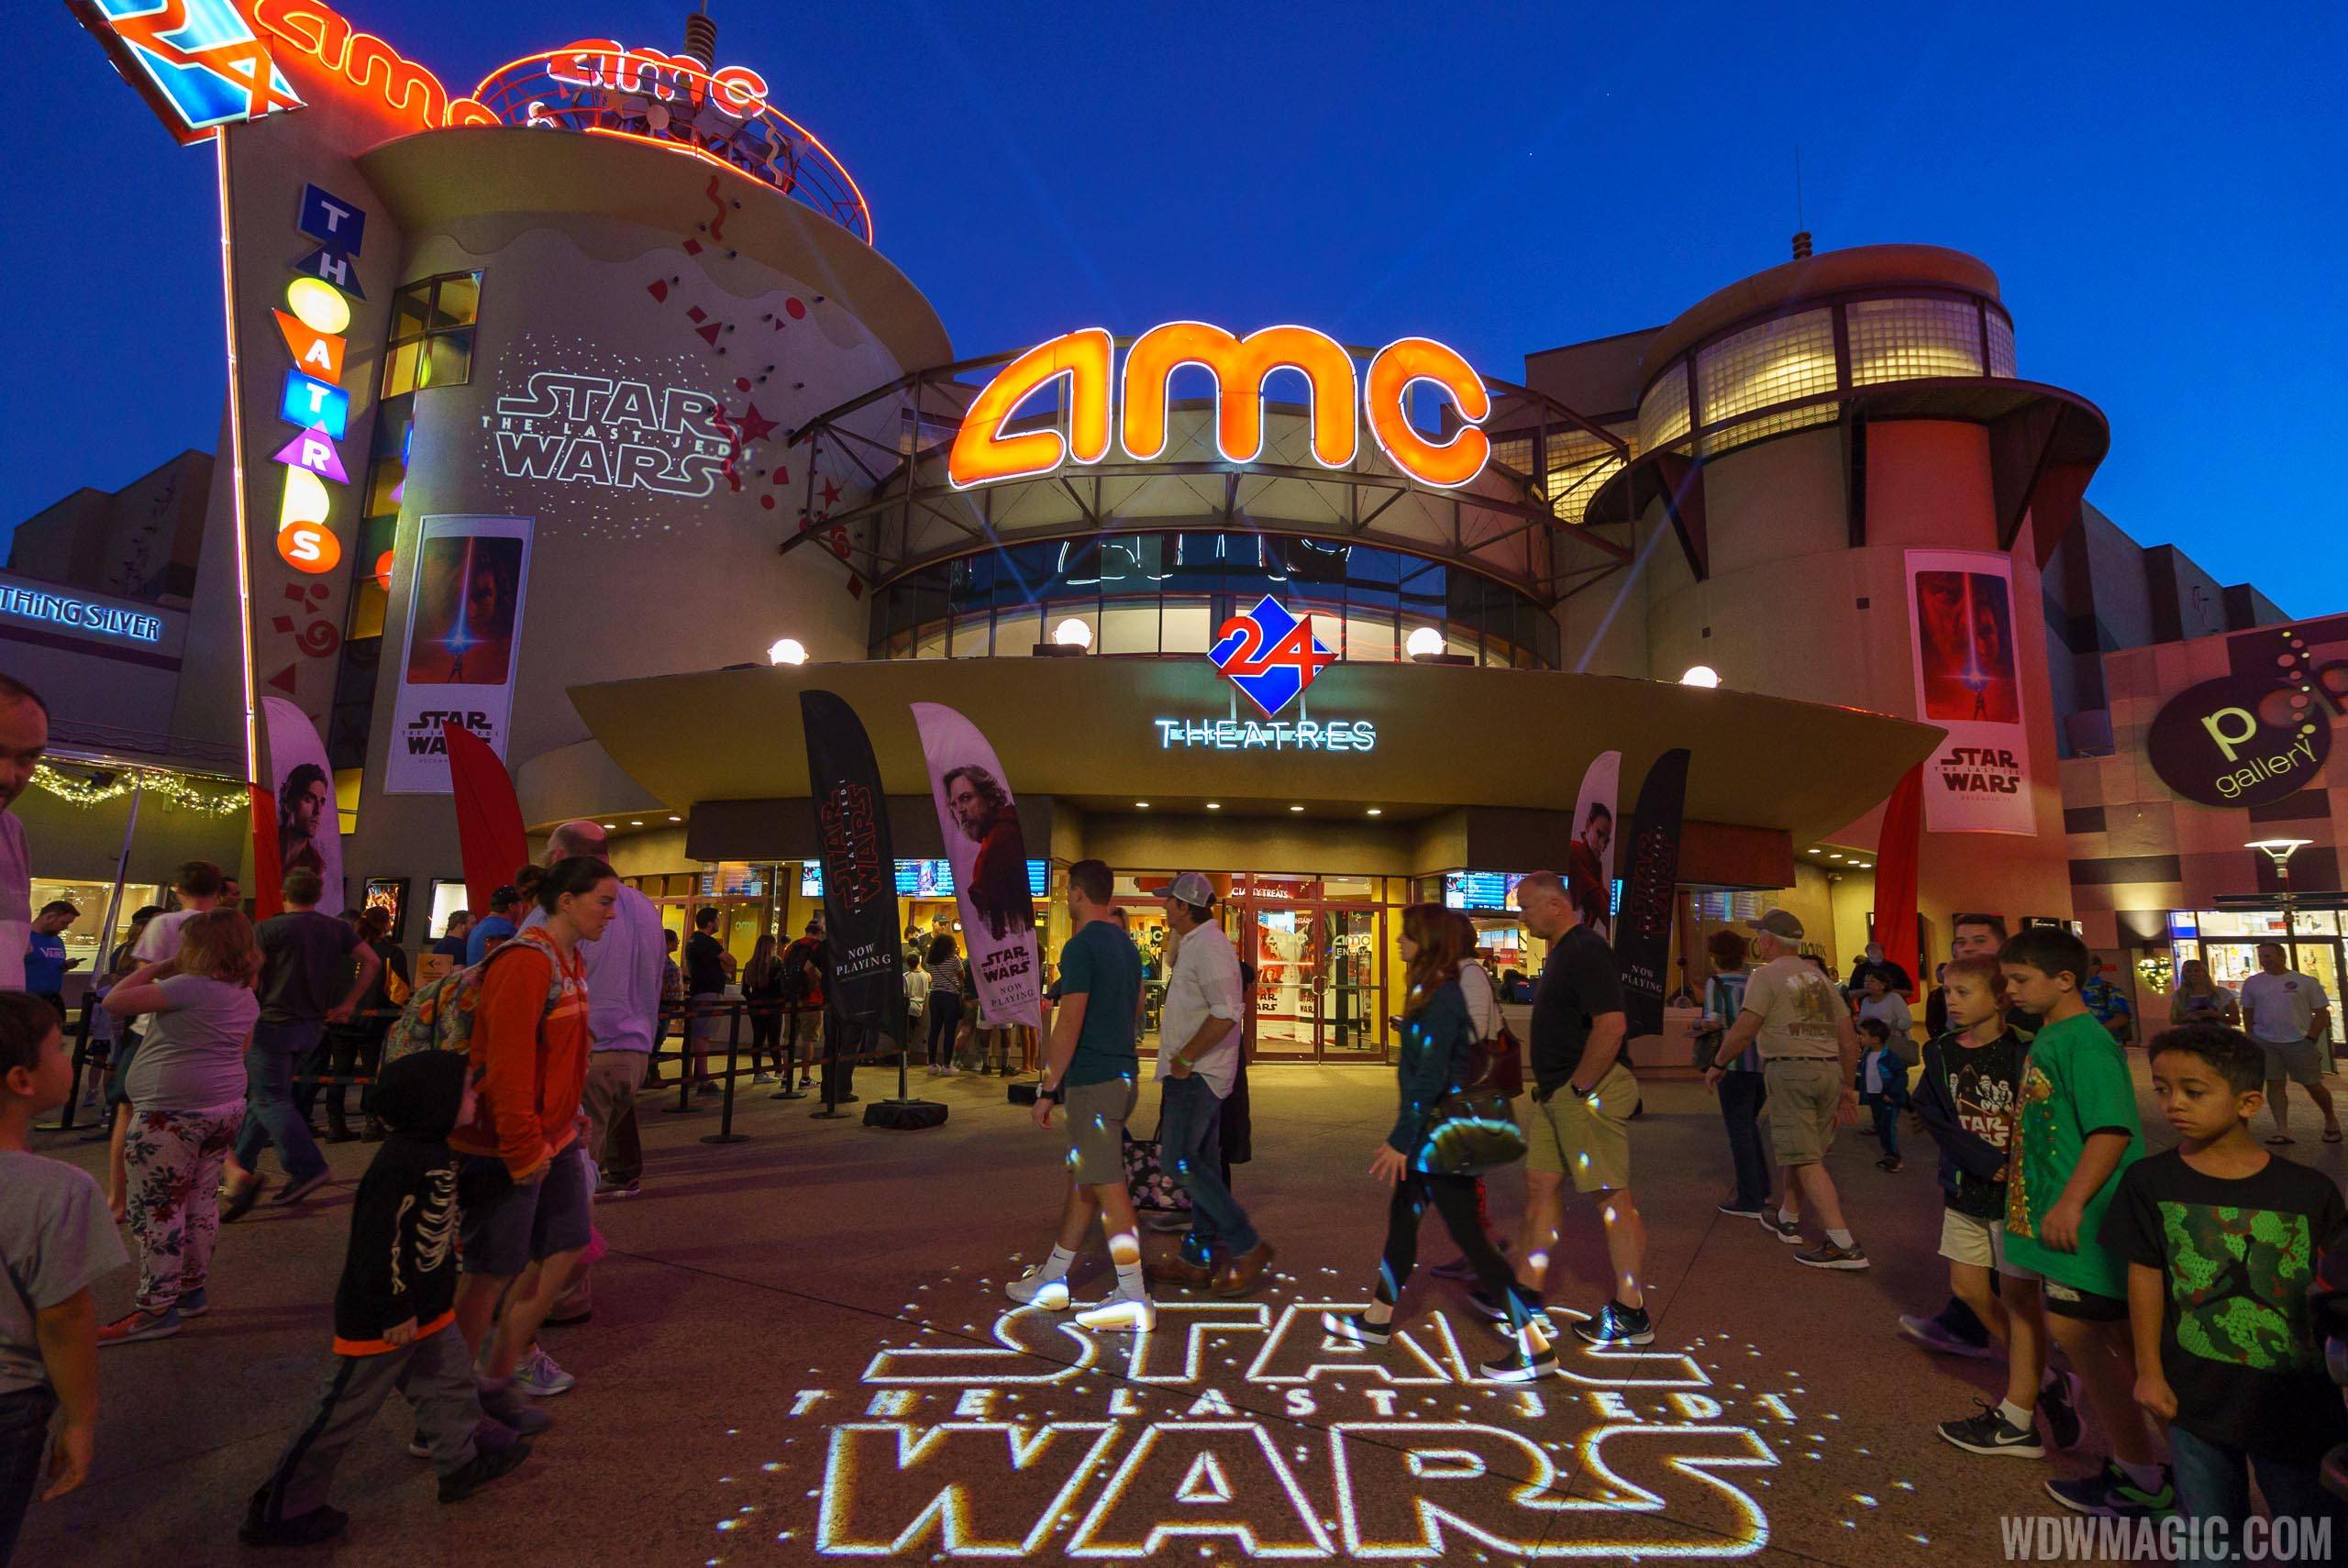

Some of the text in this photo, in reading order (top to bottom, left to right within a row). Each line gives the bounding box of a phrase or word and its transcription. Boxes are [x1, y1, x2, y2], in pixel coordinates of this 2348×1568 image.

[548, 39, 769, 118] amc
[496, 371, 733, 442] STAR
[948, 320, 1491, 489] amc
[482, 415, 753, 461] THE LAST JEDI
[495, 432, 731, 498] WARS
[1216, 614, 1339, 692] 24
[408, 711, 493, 730] STAR
[1155, 719, 1376, 750] THEATRES
[1941, 748, 2019, 768] STAR
[2215, 738, 2318, 799] gallery
[1942, 773, 2021, 794] WARS
[847, 943, 874, 960] NOW
[981, 945, 1029, 968] STAR
[836, 954, 892, 977] PLAYING
[983, 960, 1030, 984] WARS
[1632, 965, 1655, 978] NOW
[1000, 982, 1023, 996] NOW
[1621, 973, 1663, 993] PLAYING
[991, 989, 1035, 1008] PLAYING
[1958, 1114, 2010, 1133] TAR
[786, 1387, 1798, 1420] THE LAST JEDI
[815, 1421, 1781, 1559] WARS
